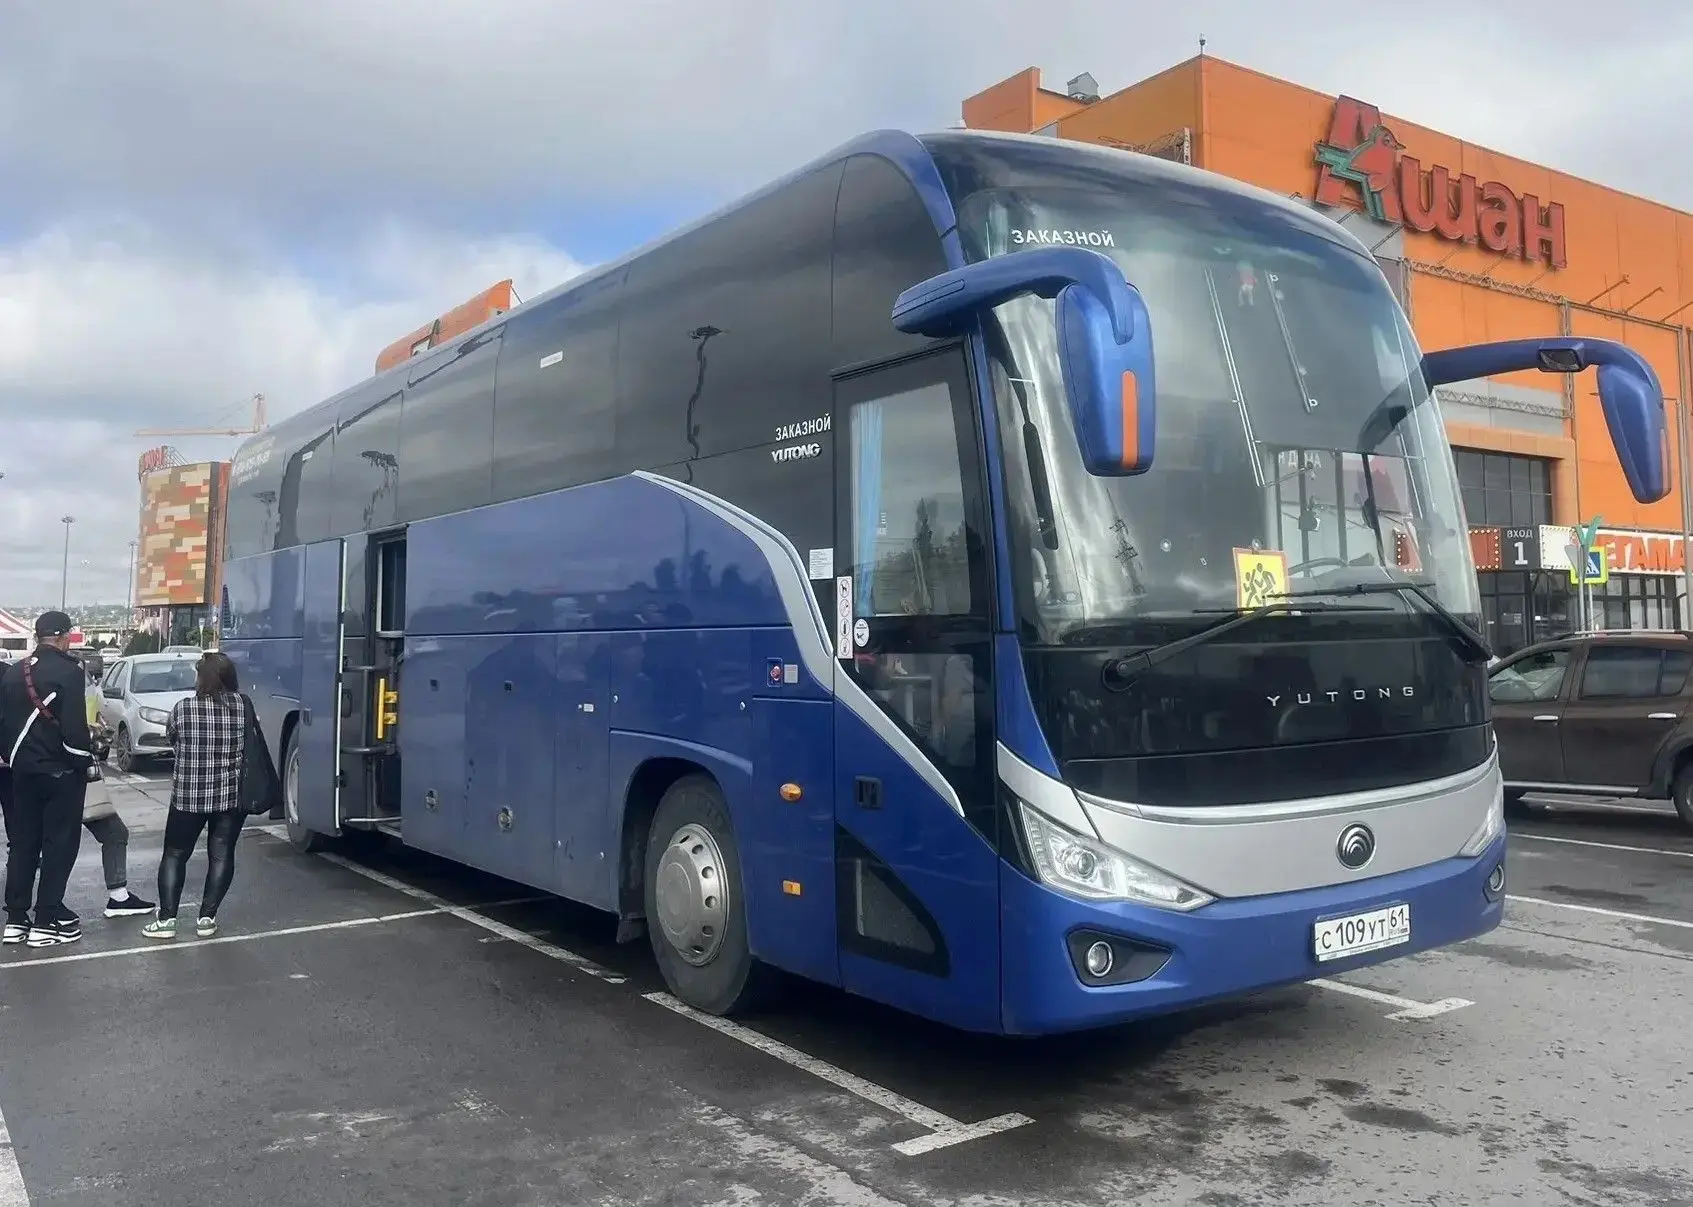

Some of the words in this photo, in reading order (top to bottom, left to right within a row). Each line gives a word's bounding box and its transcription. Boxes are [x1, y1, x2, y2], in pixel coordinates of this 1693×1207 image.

[1011, 229, 1115, 247] ЗАКАЗНОЙ
[775, 412, 832, 442] ЗАКАЗНОЙ
[771, 443, 821, 463] YUTONG
[1506, 529, 1533, 539] ВХОД
[1514, 541, 1528, 565] 1
[1266, 686, 1414, 707] YUTONG
[1390, 907, 1405, 928] 61
